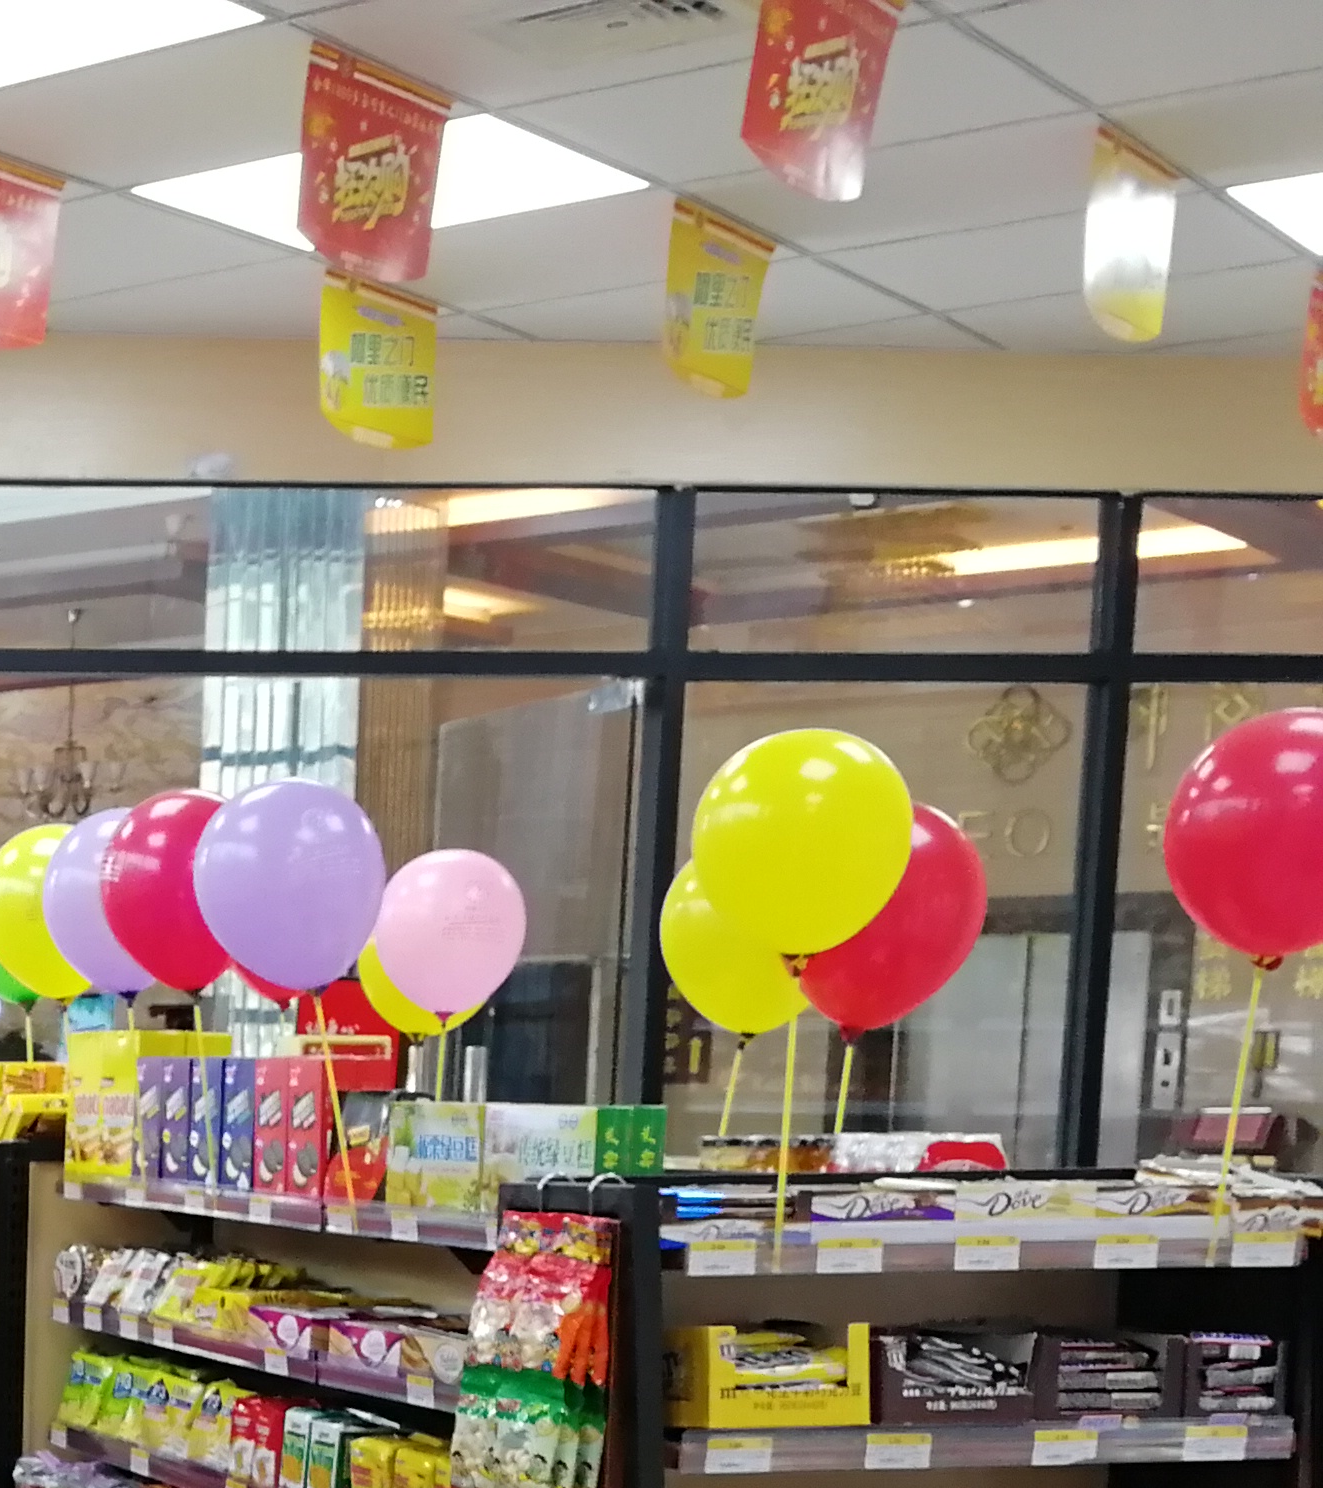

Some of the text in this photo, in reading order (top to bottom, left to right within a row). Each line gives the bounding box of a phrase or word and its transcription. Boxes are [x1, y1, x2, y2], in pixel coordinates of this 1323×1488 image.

[846, 1195, 902, 1219] Dove
[987, 1191, 1048, 1216] Dove
[1128, 1190, 1181, 1215] Dove
